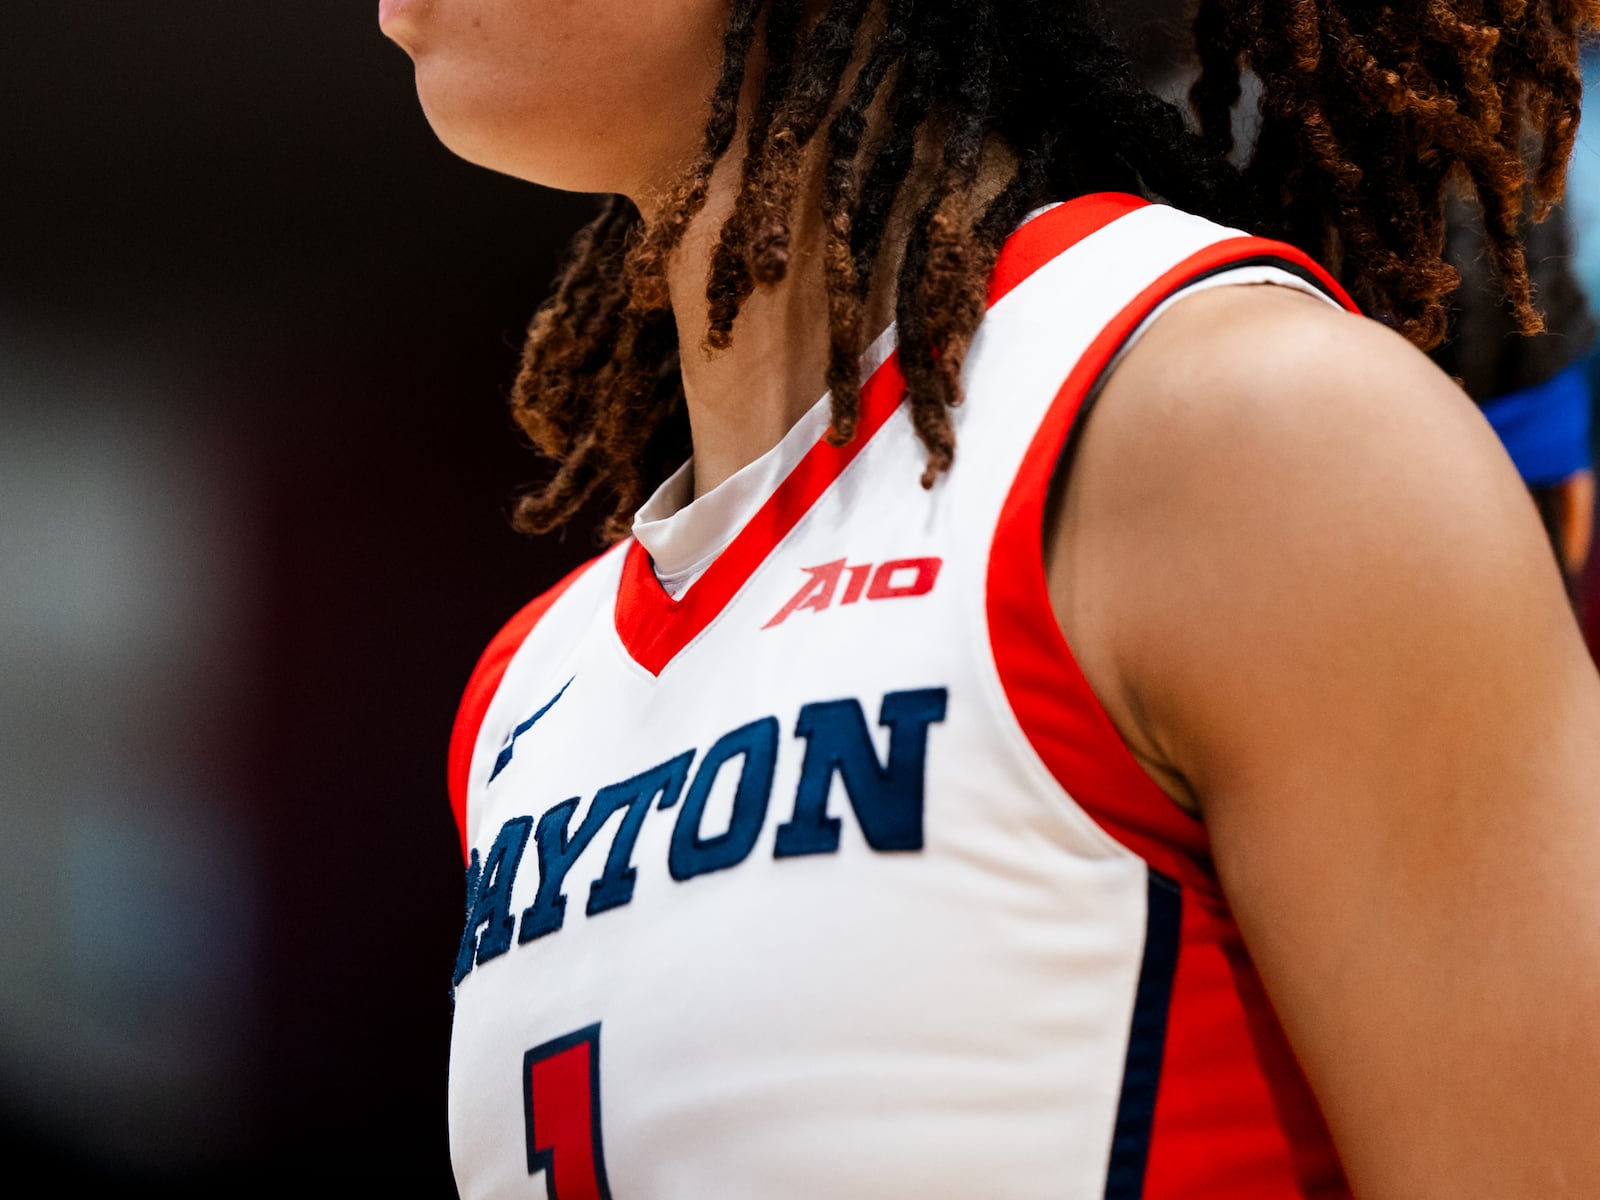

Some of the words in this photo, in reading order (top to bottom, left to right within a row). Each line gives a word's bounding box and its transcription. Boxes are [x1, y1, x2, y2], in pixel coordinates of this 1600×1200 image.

[760, 557, 943, 630] A10
[450, 686, 949, 996] AYTON
[523, 1020, 613, 1200] 1
